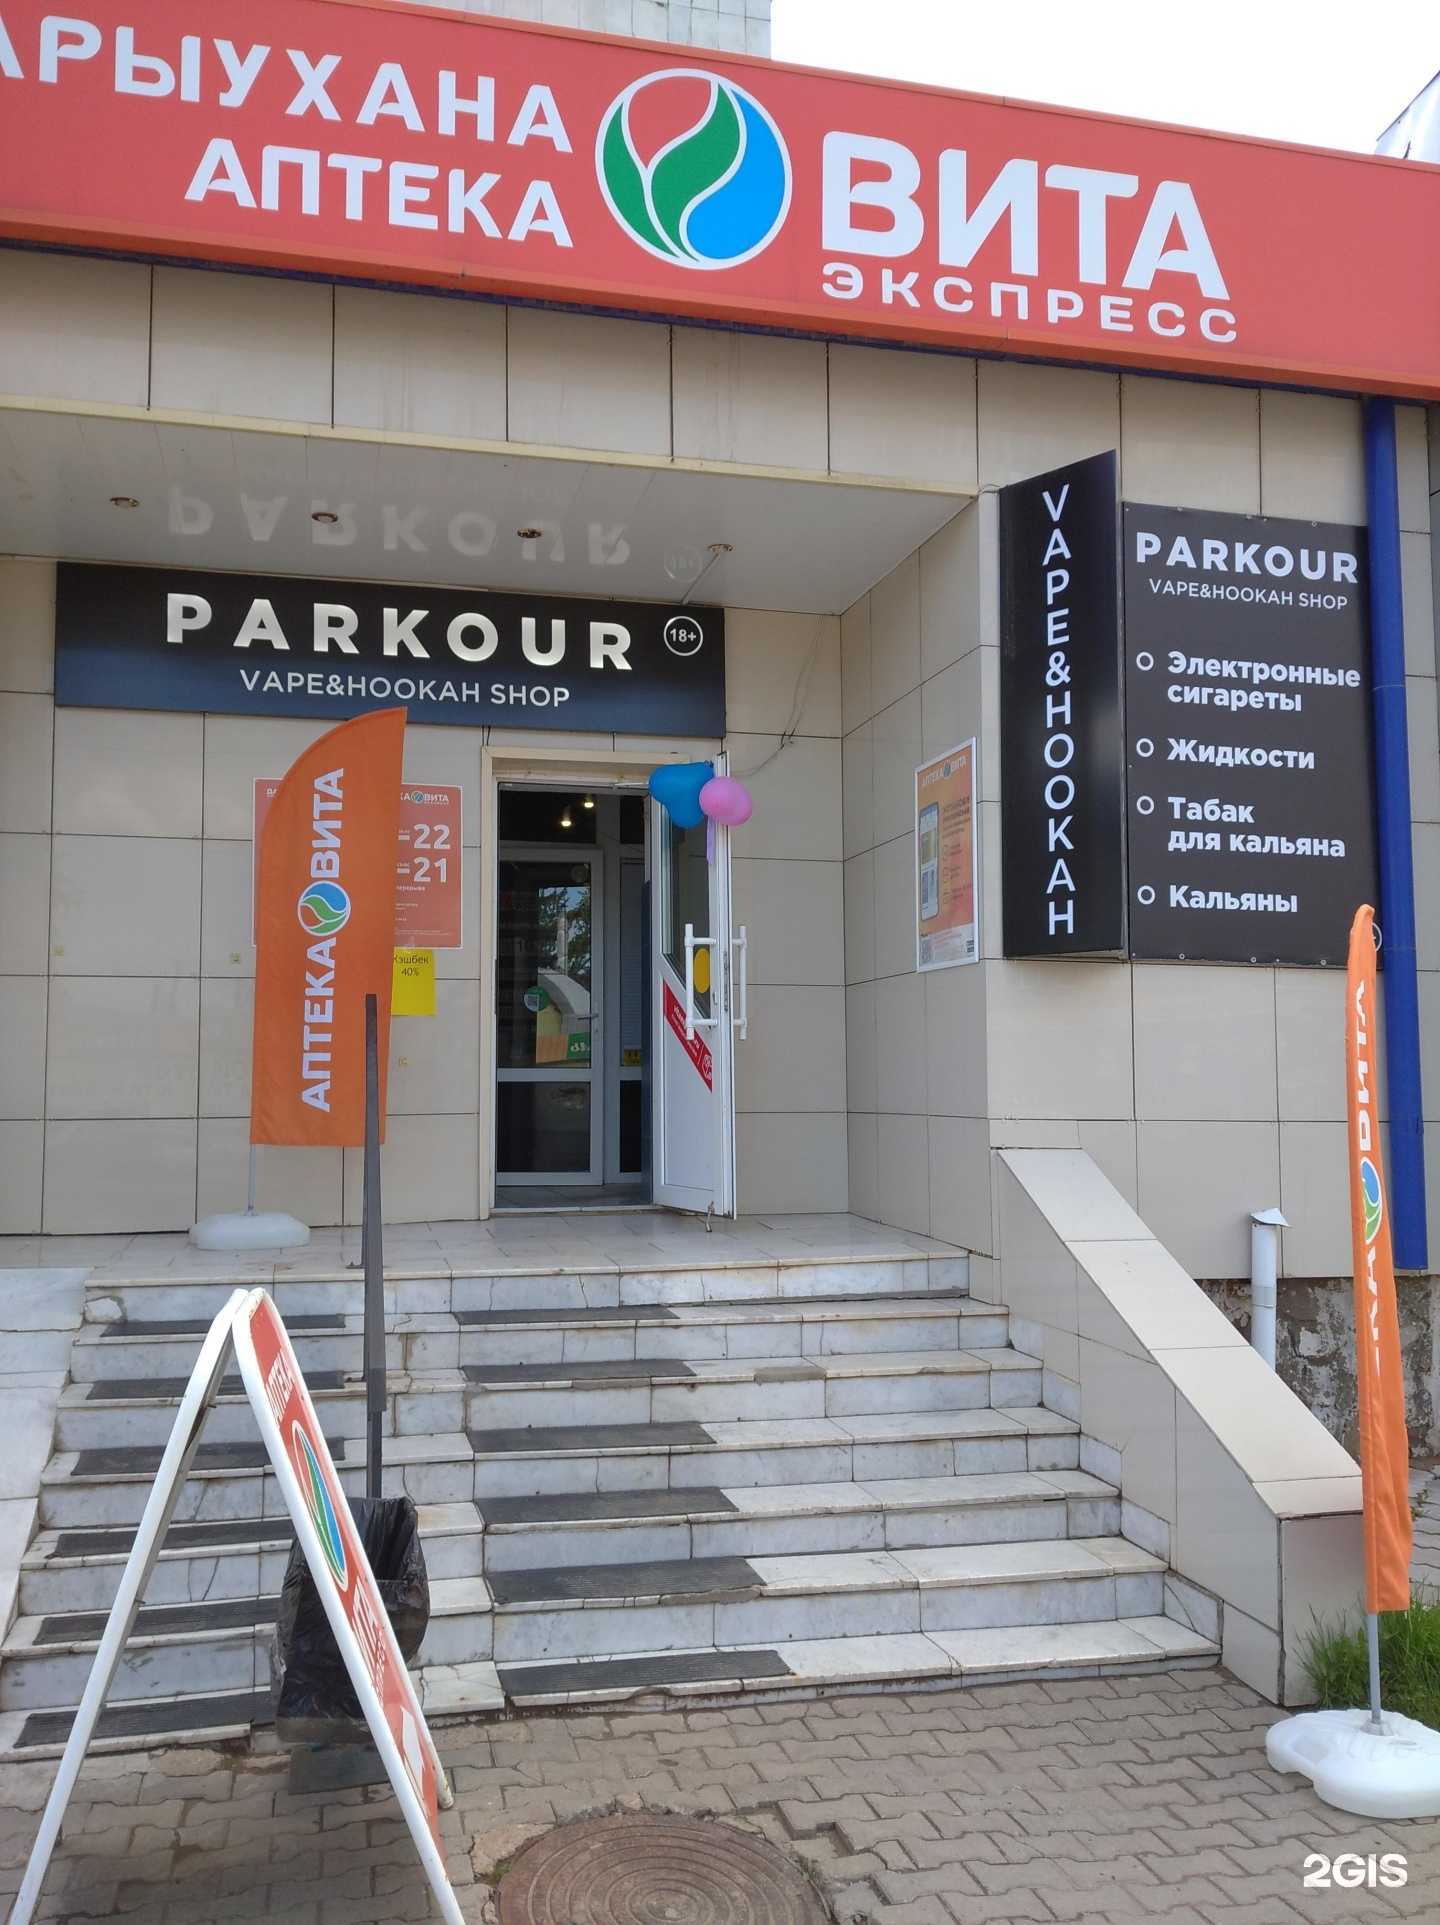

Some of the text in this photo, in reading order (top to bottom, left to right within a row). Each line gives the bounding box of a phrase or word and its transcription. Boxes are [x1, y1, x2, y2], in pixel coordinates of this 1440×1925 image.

[185, 138, 573, 248] АПТЕКА
[821, 131, 1231, 300] ВИТА
[822, 262, 1237, 343] ЭКСПРЕСС
[1136, 531, 1358, 585] PARKOUR
[1149, 578, 1348, 610] VAPE&HOOKAH SHOP
[166, 593, 632, 671] PARKOUR
[669, 628, 697, 643] 18+
[240, 669, 570, 708] VAPE&HOOKAH SHOP
[1168, 651, 1361, 688] Электронные
[1042, 484, 1075, 935] VAPE&HOOKAH
[1168, 684, 1302, 712] сигареты
[1168, 738, 1315, 769] Жидкости
[1168, 796, 1254, 824] Табак
[1168, 831, 1346, 858] для кальяна
[1169, 885, 1298, 913] Кальяны
[301, 768, 344, 1113] АПТЕКА ВИТА
